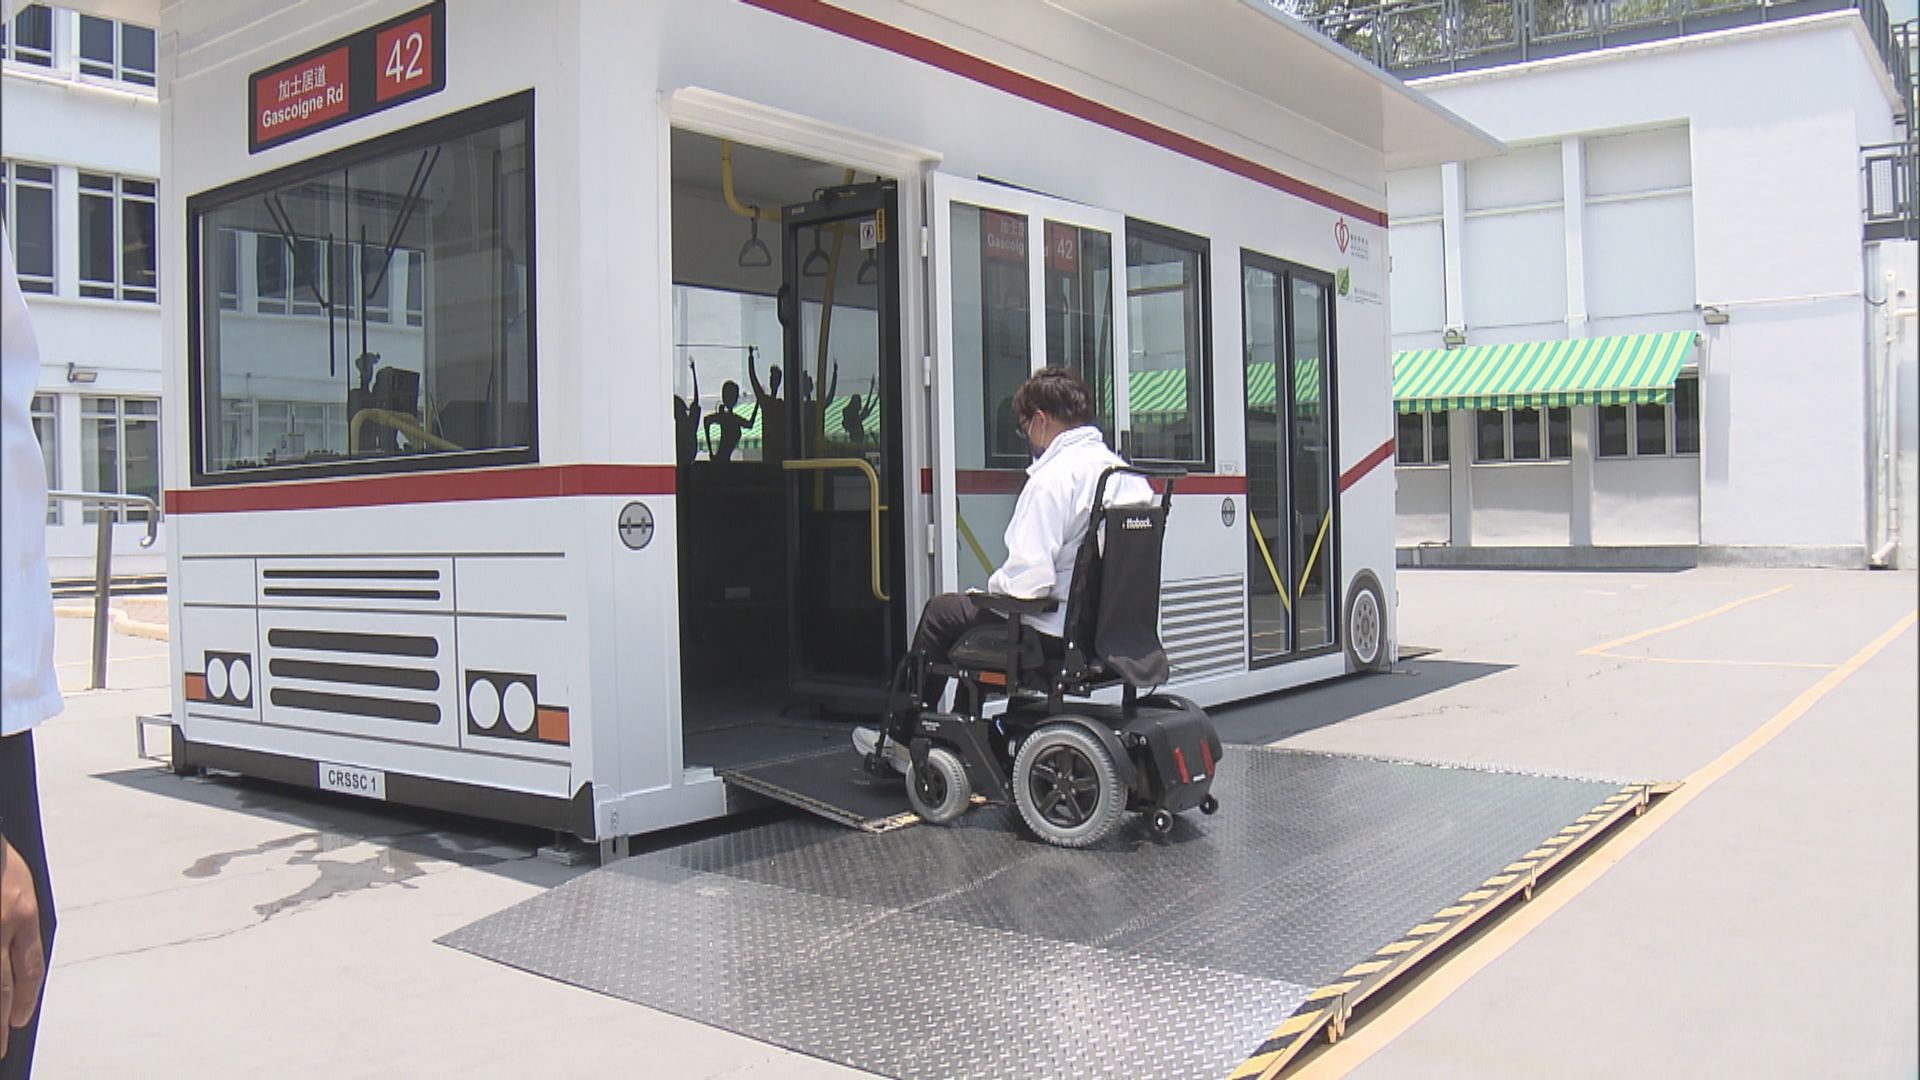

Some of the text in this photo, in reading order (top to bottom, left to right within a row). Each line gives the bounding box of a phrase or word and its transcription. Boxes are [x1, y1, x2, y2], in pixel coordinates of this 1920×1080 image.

[385, 32, 424, 84] 42
[278, 64, 327, 101] 加士居道
[262, 83, 344, 128] Gascoigne Rd
[1057, 239, 1073, 260] 42
[328, 770, 376, 792] CRSSC 1
